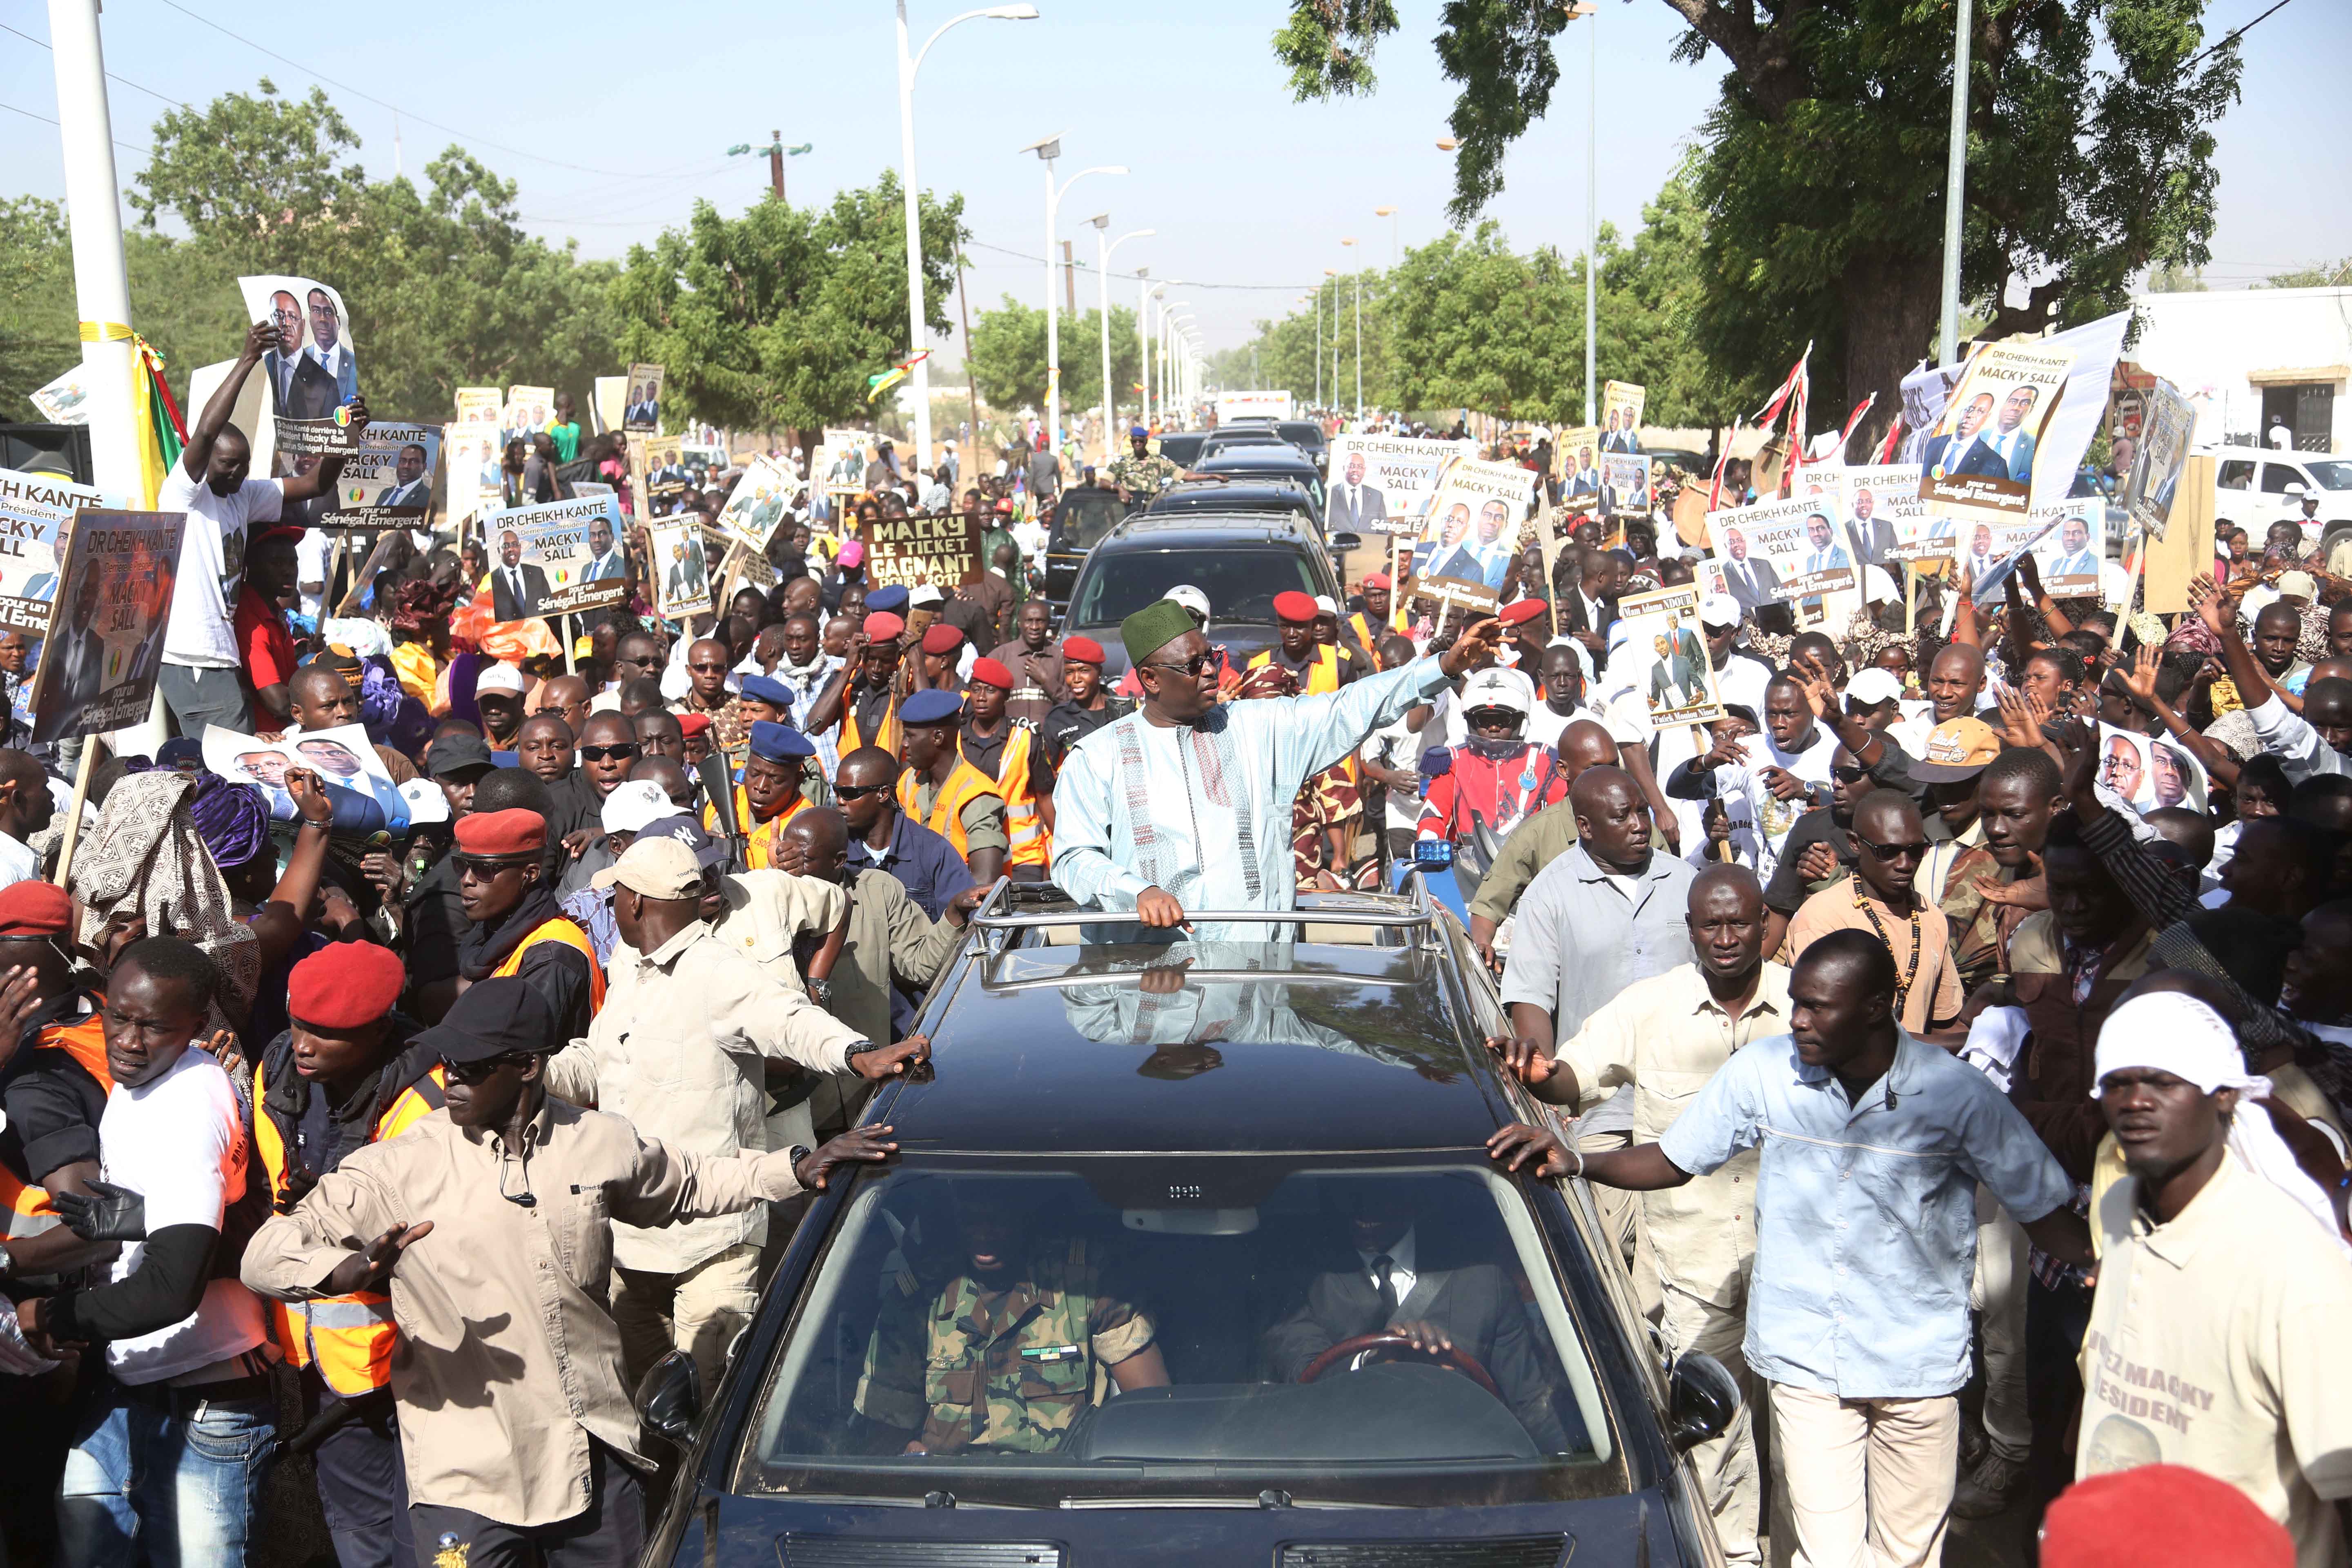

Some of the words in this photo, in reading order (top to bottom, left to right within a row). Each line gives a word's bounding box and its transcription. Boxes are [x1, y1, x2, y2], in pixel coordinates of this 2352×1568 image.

[2006, 353, 2038, 363] CHEIKH
[2039, 358, 2068, 367] KANTÉ
[1978, 366, 2027, 382] MACKY
[2028, 373, 2058, 384] SALL
[302, 433, 329, 444] Macky
[330, 435, 347, 444] Sall
[380, 428, 427, 442] KANTÉ
[297, 442, 322, 453] Sénégal
[324, 445, 359, 455] Emergent
[1348, 441, 1364, 451] DR
[1368, 442, 1414, 454] CHEIKH
[345, 454, 393, 467] ACKY
[2155, 445, 2169, 466] SALL
[342, 468, 379, 480] SALL
[1379, 466, 1429, 478] MACKY
[1474, 467, 1502, 477] CHEIKH
[1806, 474, 1822, 483] DR
[1387, 479, 1419, 490] SALL
[1452, 479, 1494, 494] MACKY
[1854, 478, 1870, 488] DR
[1873, 474, 1918, 486] CHEIKH
[1967, 480, 1985, 489] pour
[1496, 488, 1523, 501] SALL
[1887, 494, 1925, 506] MACK
[1933, 482, 1974, 500] Sénégal
[1973, 488, 2025, 506] Emergent
[1, 502, 56, 520] Président
[359, 508, 380, 516] pour
[496, 516, 514, 529] DR
[517, 508, 564, 525] CHEIKH
[566, 501, 608, 519] KANTÉ
[1719, 516, 1737, 527] DR
[1738, 509, 1780, 523] CHEIKH
[1782, 499, 1822, 517] KANTÉ
[1895, 507, 1924, 517] SALL
[2135, 498, 2148, 521] Sénégal
[321, 512, 367, 527] Sénégal
[368, 514, 422, 528] Emergent
[1371, 519, 1412, 534] Sénégal
[521, 527, 548, 536] Derrière
[556, 521, 586, 531] Président
[873, 516, 966, 541] MACKY
[1757, 528, 1801, 544] MACKY
[87, 530, 106, 554] DR
[107, 530, 145, 553] CHEIKH
[535, 531, 582, 550] MACKY
[869, 542, 896, 558] LE
[903, 538, 969, 555] TICKET
[544, 548, 576, 562] SALL
[1768, 542, 1798, 555] SALL
[1884, 545, 1923, 561] Sénégal
[871, 553, 973, 578] GAGNANT
[925, 573, 961, 587] 2017
[1797, 574, 1814, 584] pour
[108, 580, 150, 605] MACKY
[568, 584, 587, 595] pour
[1770, 580, 1808, 600] Sénégal
[2045, 581, 2096, 596] Emergent
[537, 592, 578, 611] Sénégal
[577, 585, 625, 603] Emergent
[29, 604, 47, 614] un
[1623, 606, 1641, 618] Mam
[1641, 603, 1663, 615] Adama
[1662, 595, 1693, 610] NDOUR
[110, 608, 135, 632] SALL
[112, 686, 126, 702] pour
[127, 685, 135, 696] un
[77, 699, 117, 728] Sénégal
[115, 694, 151, 722] Emergent
[1058, 725, 1079, 737] POLICE
[1931, 730, 1961, 748] Utah
[677, 869, 689, 879] Tour
[2125, 1361, 2215, 1411] MACKY
